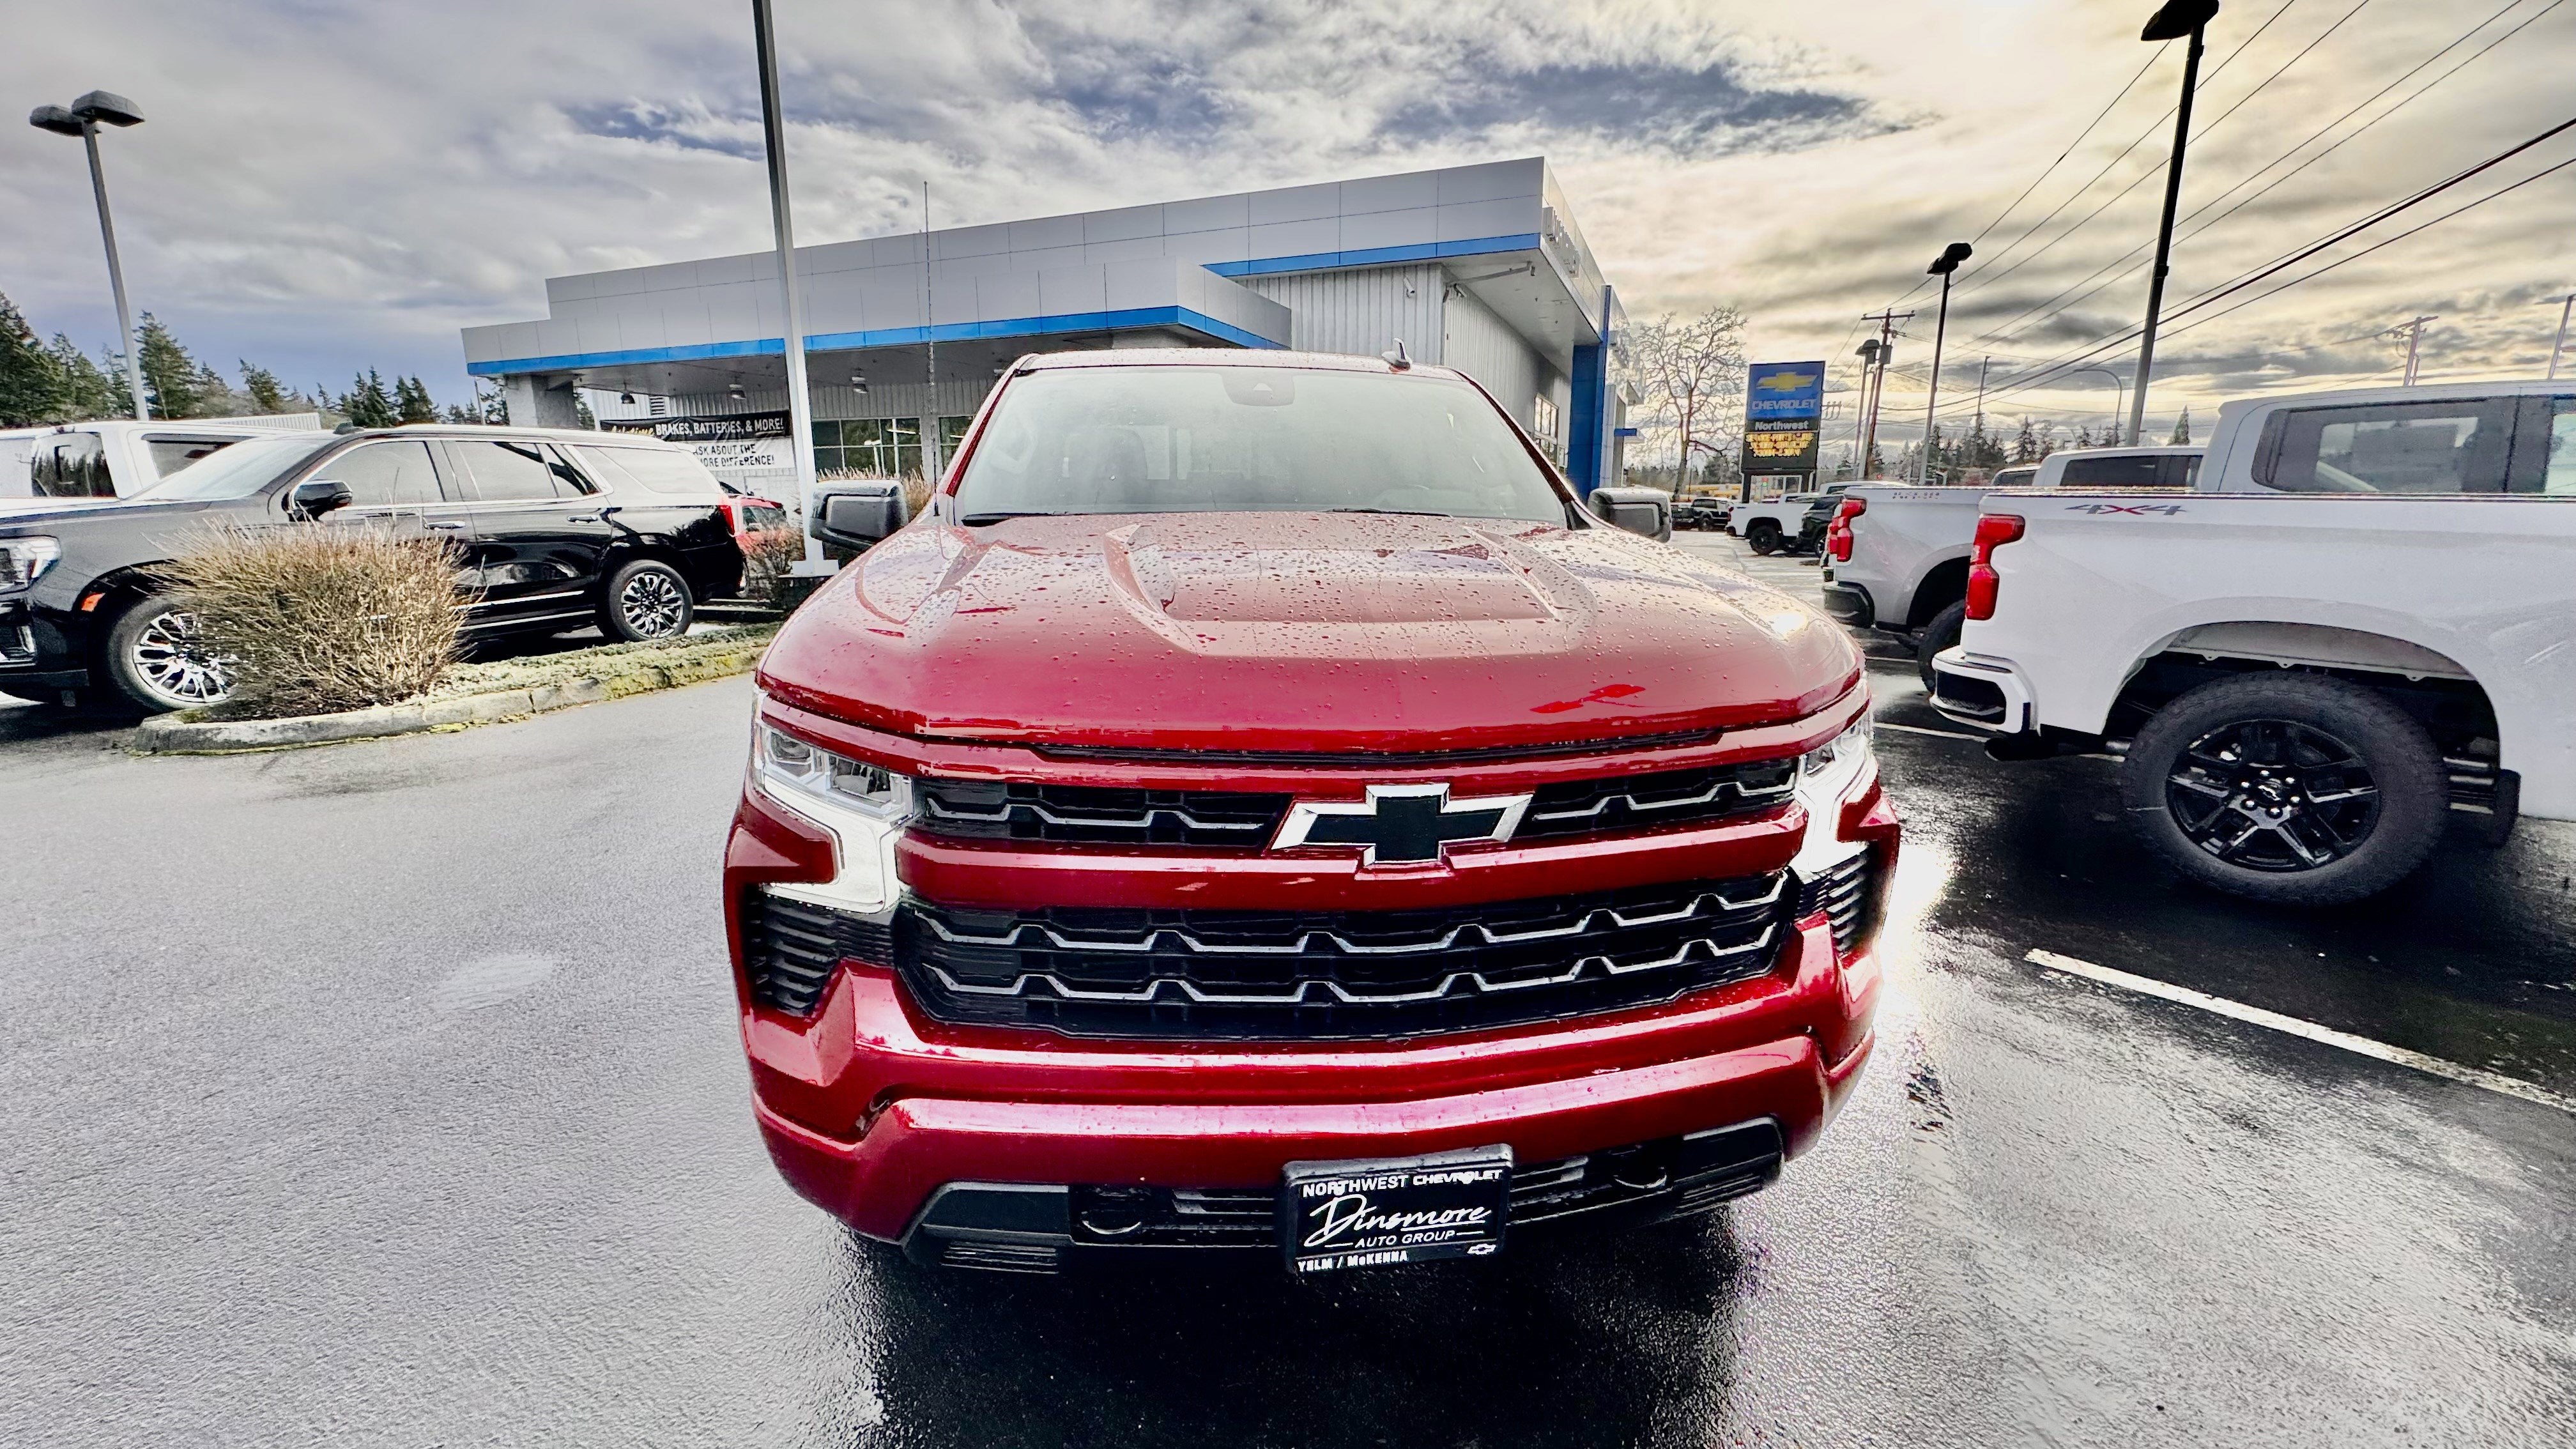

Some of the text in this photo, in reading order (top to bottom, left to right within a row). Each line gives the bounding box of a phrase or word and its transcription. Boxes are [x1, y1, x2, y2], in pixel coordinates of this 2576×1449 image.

[1751, 399, 1816, 410] CHEVROLET
[656, 422, 693, 436] BRAKES,
[693, 420, 744, 434] BATTERIES,
[746, 420, 753, 432] &
[755, 417, 785, 431] MORE!
[1754, 420, 1809, 431] Northwest
[711, 445, 739, 455] ABOUT
[740, 443, 756, 454] THE
[721, 454, 775, 467] DIFFERENCE!
[1303, 1169, 1503, 1198] NORTHWEST CHEVROLET
[1304, 1193, 1492, 1247] Dinsmore
[1354, 1230, 1456, 1248] AUTO GROUP
[1298, 1257, 1333, 1272] YELM
